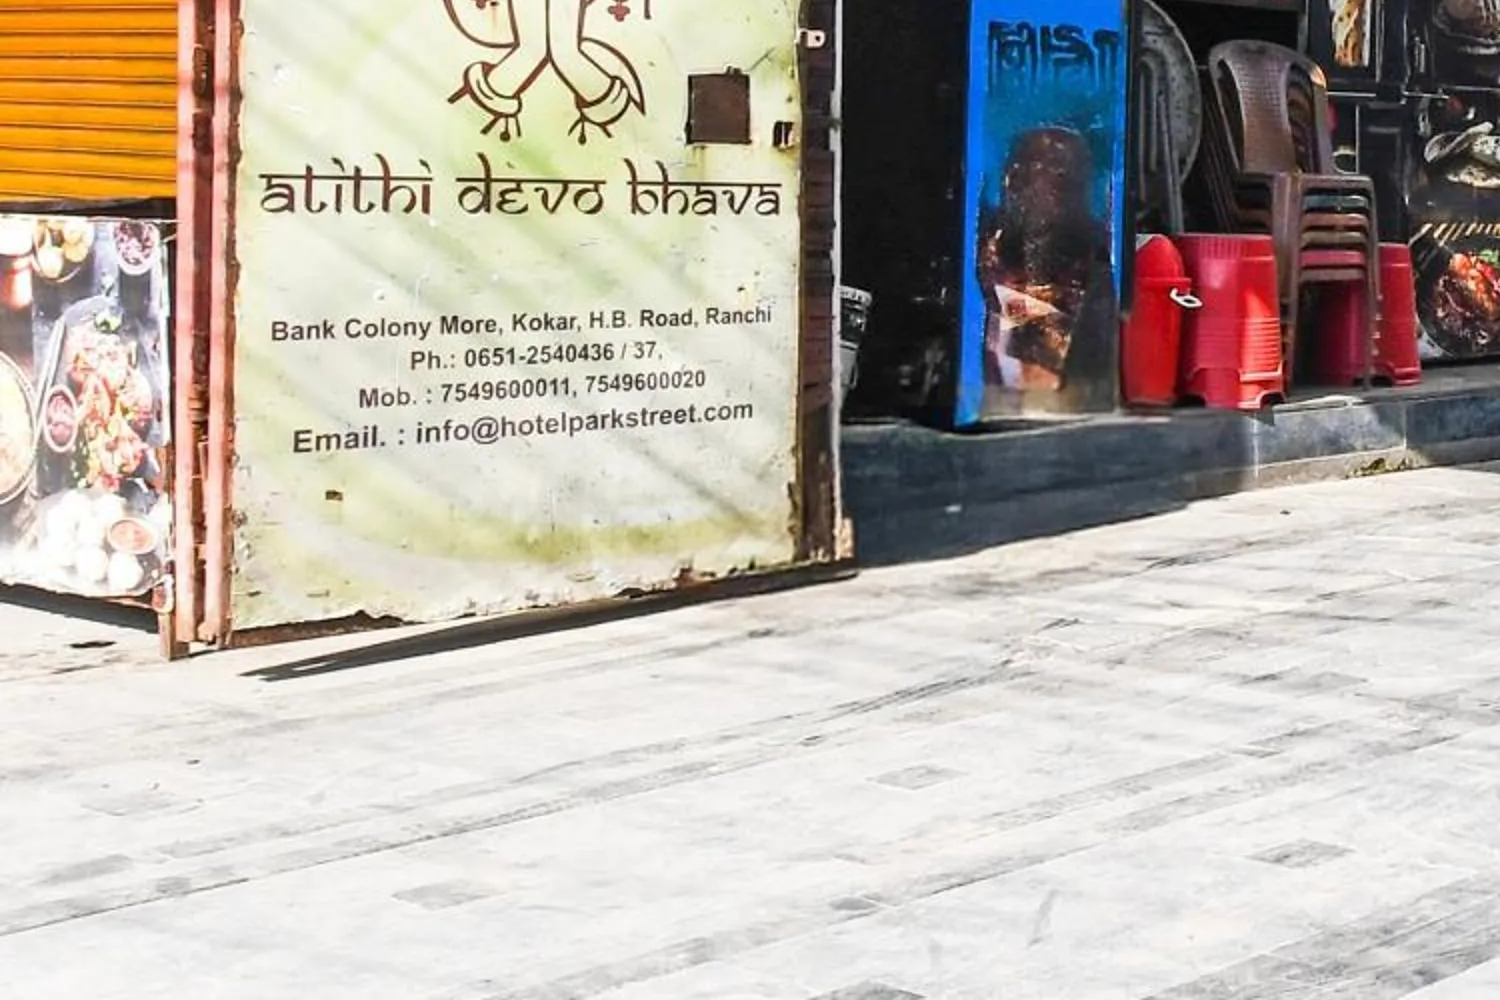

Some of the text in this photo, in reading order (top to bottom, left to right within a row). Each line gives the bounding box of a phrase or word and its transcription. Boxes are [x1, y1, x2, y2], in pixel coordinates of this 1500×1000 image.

[257, 151, 783, 216] atithi devo bhava
[271, 305, 772, 342] Bank Colony More, Kokar, H.B. Road, Ranchi
[410, 350, 456, 371] Ph.:
[463, 343, 615, 368] 0651-2540436
[633, 341, 664, 361] 37,
[358, 386, 418, 409] Mob.
[440, 377, 578, 403] 7549600011,
[585, 369, 707, 394] 7549600020
[293, 425, 387, 454] Email.
[416, 403, 754, 445] info@hotelparkstreet.com
